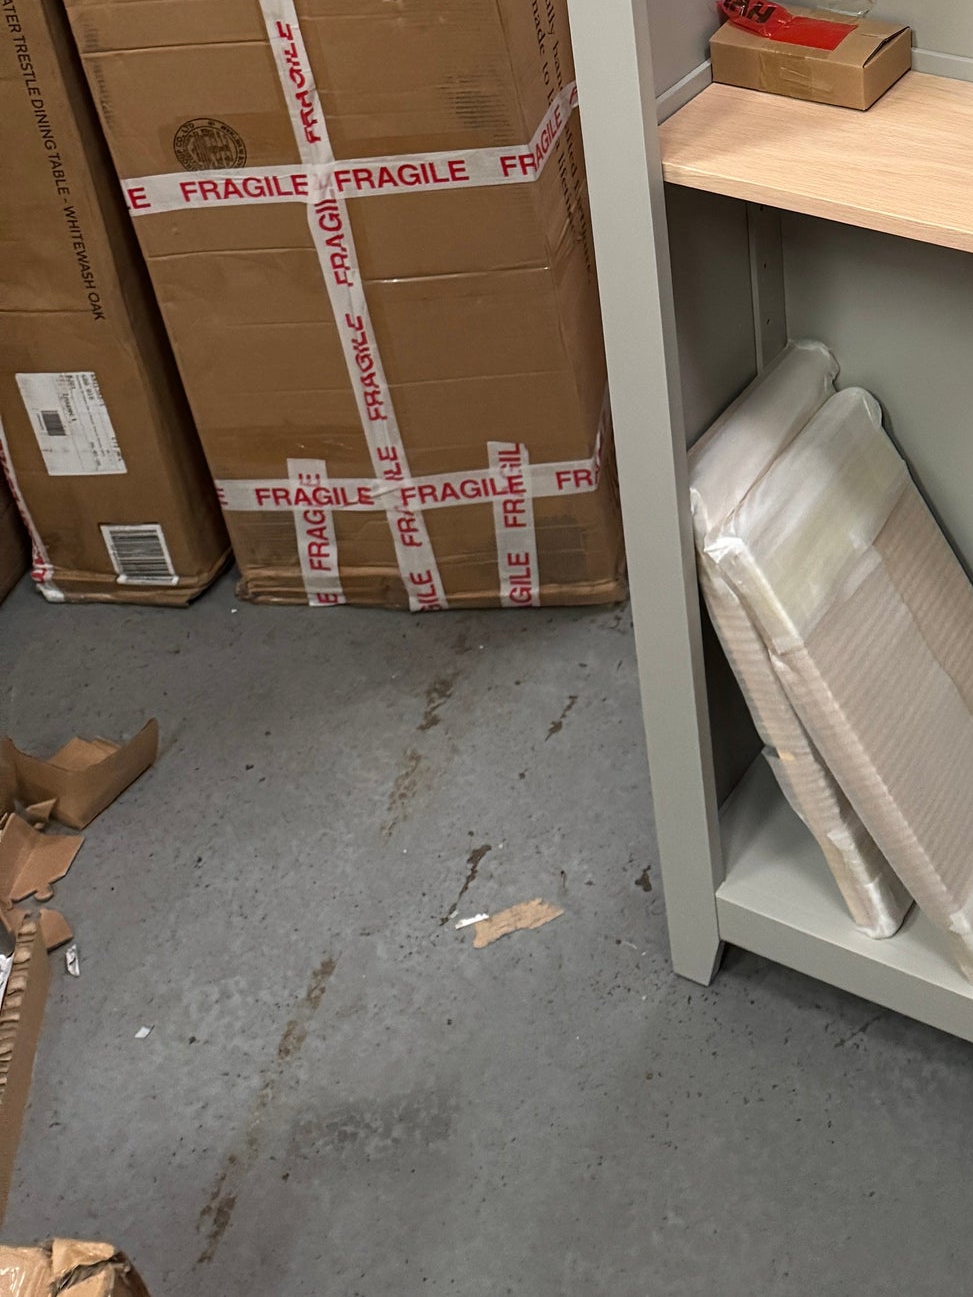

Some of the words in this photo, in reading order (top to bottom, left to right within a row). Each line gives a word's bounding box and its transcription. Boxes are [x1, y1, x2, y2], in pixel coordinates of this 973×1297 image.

[542, 61, 552, 83] to
[13, 36, 41, 96] TRESTLE
[32, 99, 57, 152] DINING
[48, 151, 71, 195] TABLE
[64, 204, 96, 290] WHITEWASH
[88, 291, 106, 320] OAK
[180, 174, 308, 202] FRAGILE
[334, 160, 469, 192] FRAGILE
[345, 313, 388, 421] FRAGILE
[255, 487, 375, 506] FRAGILE
[400, 475, 525, 507] FRAGILE
